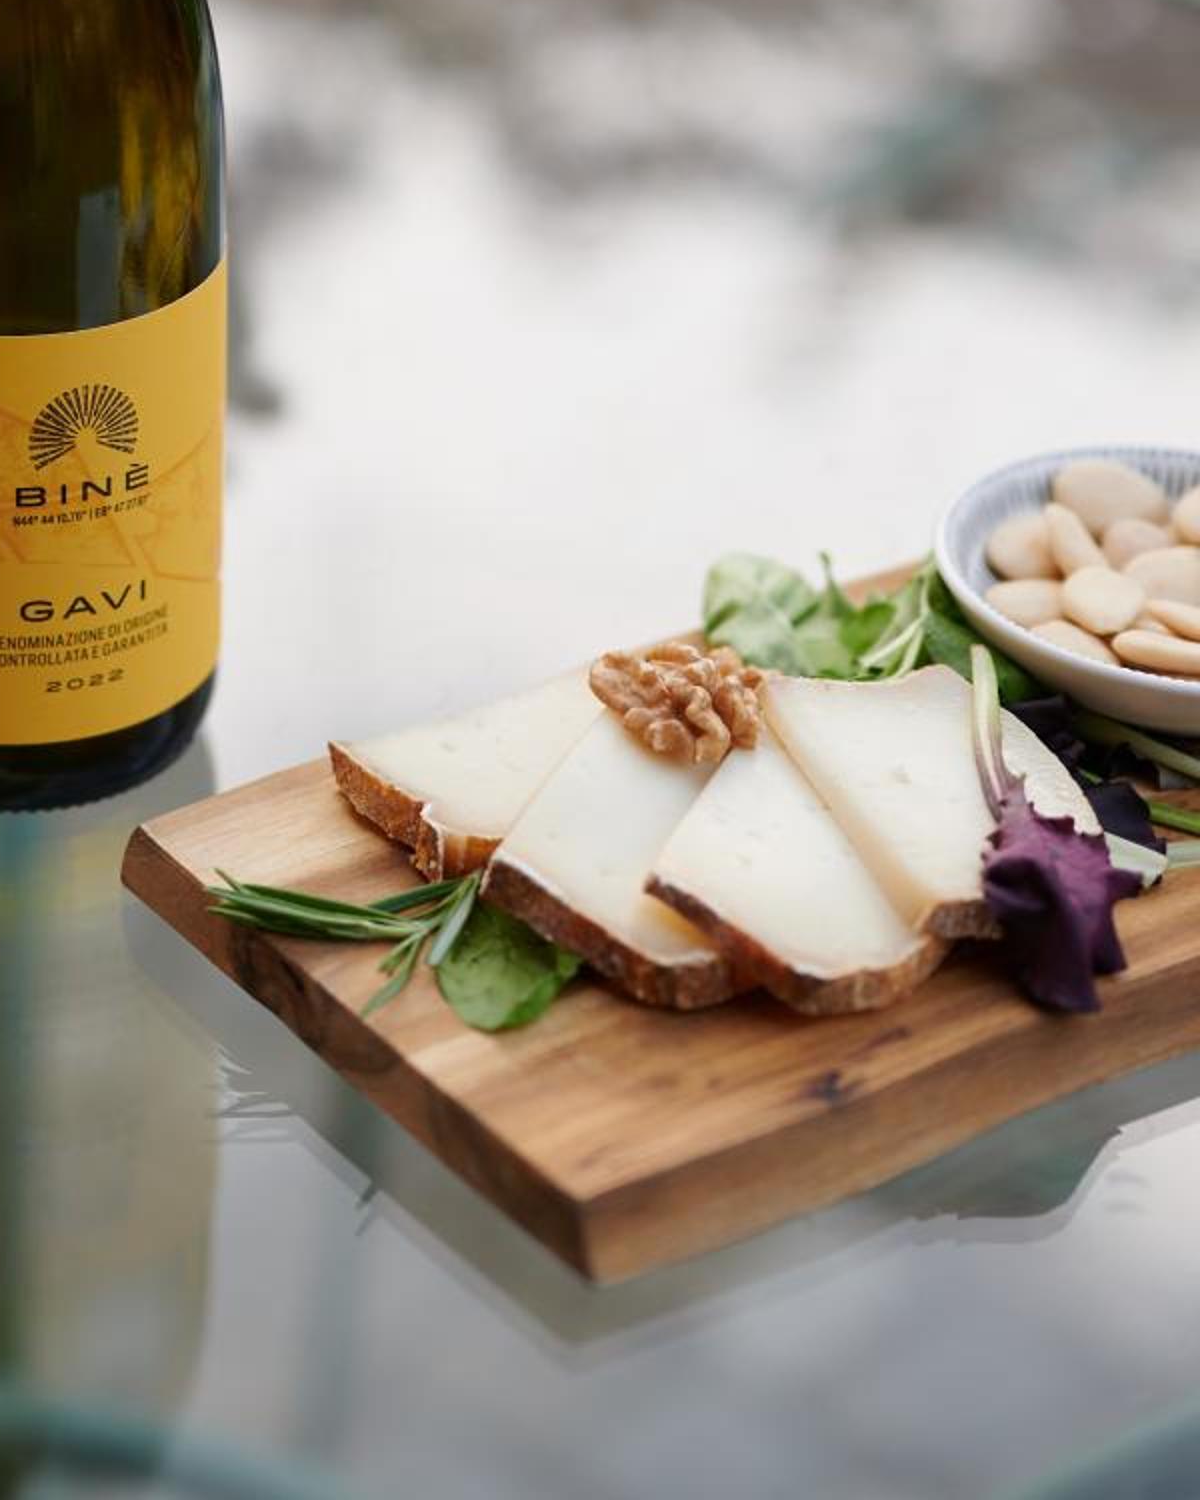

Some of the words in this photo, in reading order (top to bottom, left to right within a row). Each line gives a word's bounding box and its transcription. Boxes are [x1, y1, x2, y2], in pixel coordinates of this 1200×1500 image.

[15, 463, 149, 508] BINÈ
[19, 579, 146, 623] GAVI
[107, 623, 121, 638] DI
[123, 603, 168, 633] ORIGINE
[91, 644, 100, 659] E
[102, 621, 168, 657] GARANTITA
[45, 667, 125, 693] 2022
